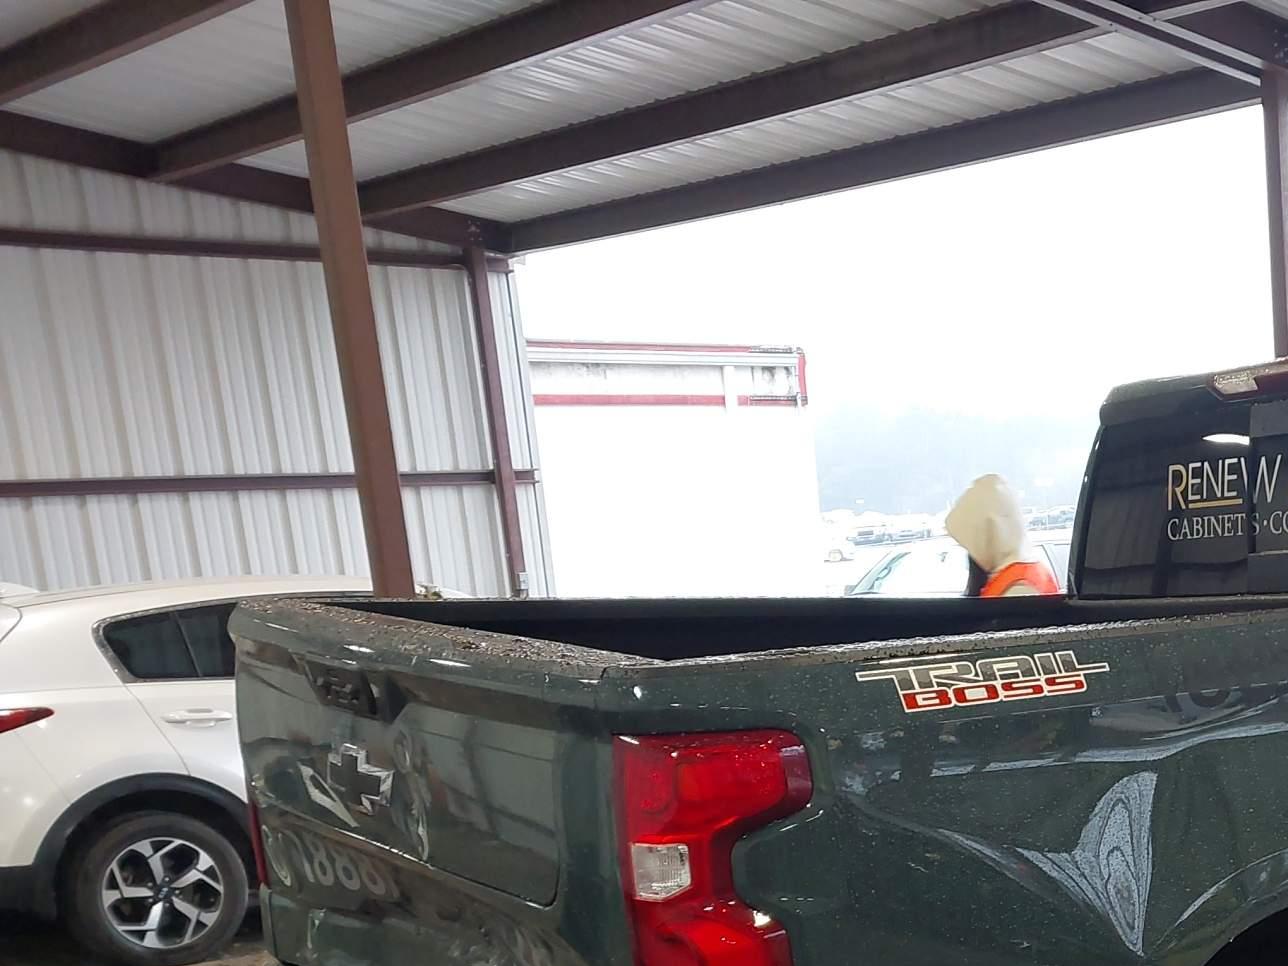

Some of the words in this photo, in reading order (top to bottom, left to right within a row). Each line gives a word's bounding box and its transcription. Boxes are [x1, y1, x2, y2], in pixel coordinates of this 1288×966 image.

[1167, 453, 1282, 511] RENEW
[855, 650, 1110, 692] TRAIL
[900, 673, 1088, 713] BOSS
